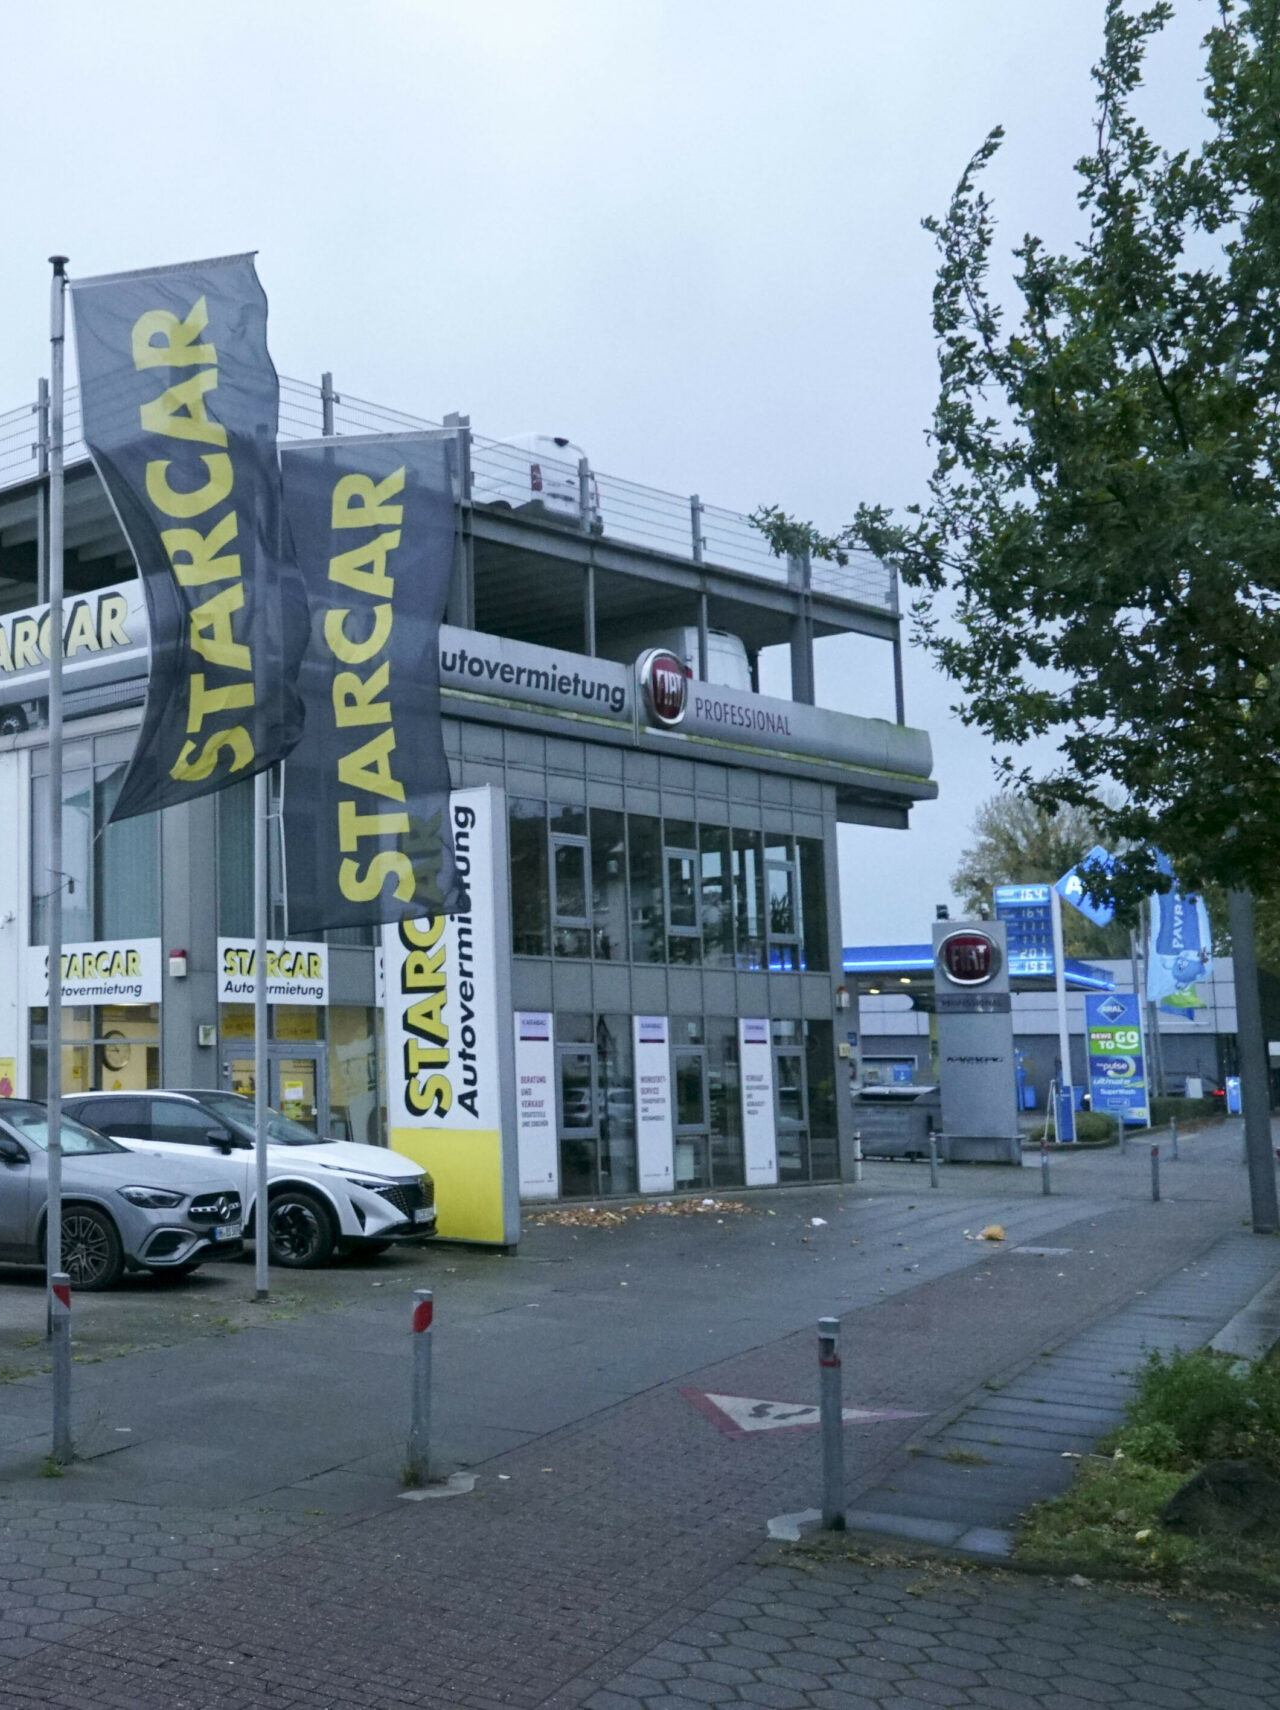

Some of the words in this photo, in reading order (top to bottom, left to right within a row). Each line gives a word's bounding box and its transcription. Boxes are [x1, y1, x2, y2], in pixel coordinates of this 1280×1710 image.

[131, 295, 255, 783] STARCAR
[324, 465, 416, 903] STARCAR
[441, 650, 626, 713] utovermietung
[655, 669, 682, 706] FIAT
[695, 697, 792, 737] PROFESSIONAL
[44, 949, 143, 980] TARCAR
[951, 945, 987, 971] FIAT
[45, 983, 143, 997] tovermietung
[223, 980, 324, 999] Autormietung
[1099, 1041, 1115, 1049] TO
[1115, 1031, 1139, 1043] GO
[1103, 1061, 1128, 1071] pulse
